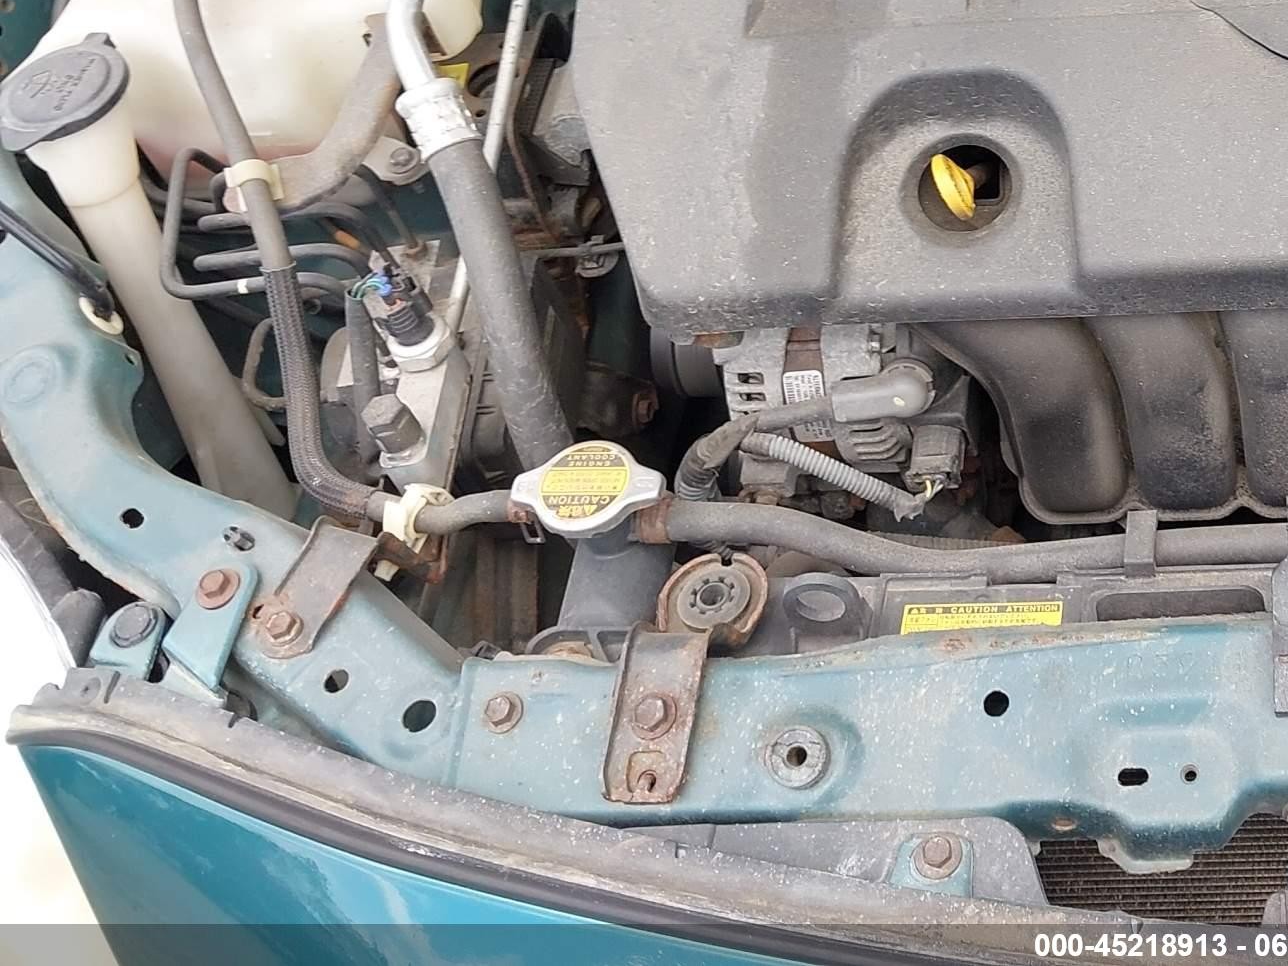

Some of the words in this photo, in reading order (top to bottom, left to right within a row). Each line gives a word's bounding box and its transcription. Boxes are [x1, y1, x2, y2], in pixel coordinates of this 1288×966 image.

[547, 495, 610, 505] CAUTION
[951, 606, 998, 614] CAUTION
[1005, 604, 1059, 613] ATTENTION
